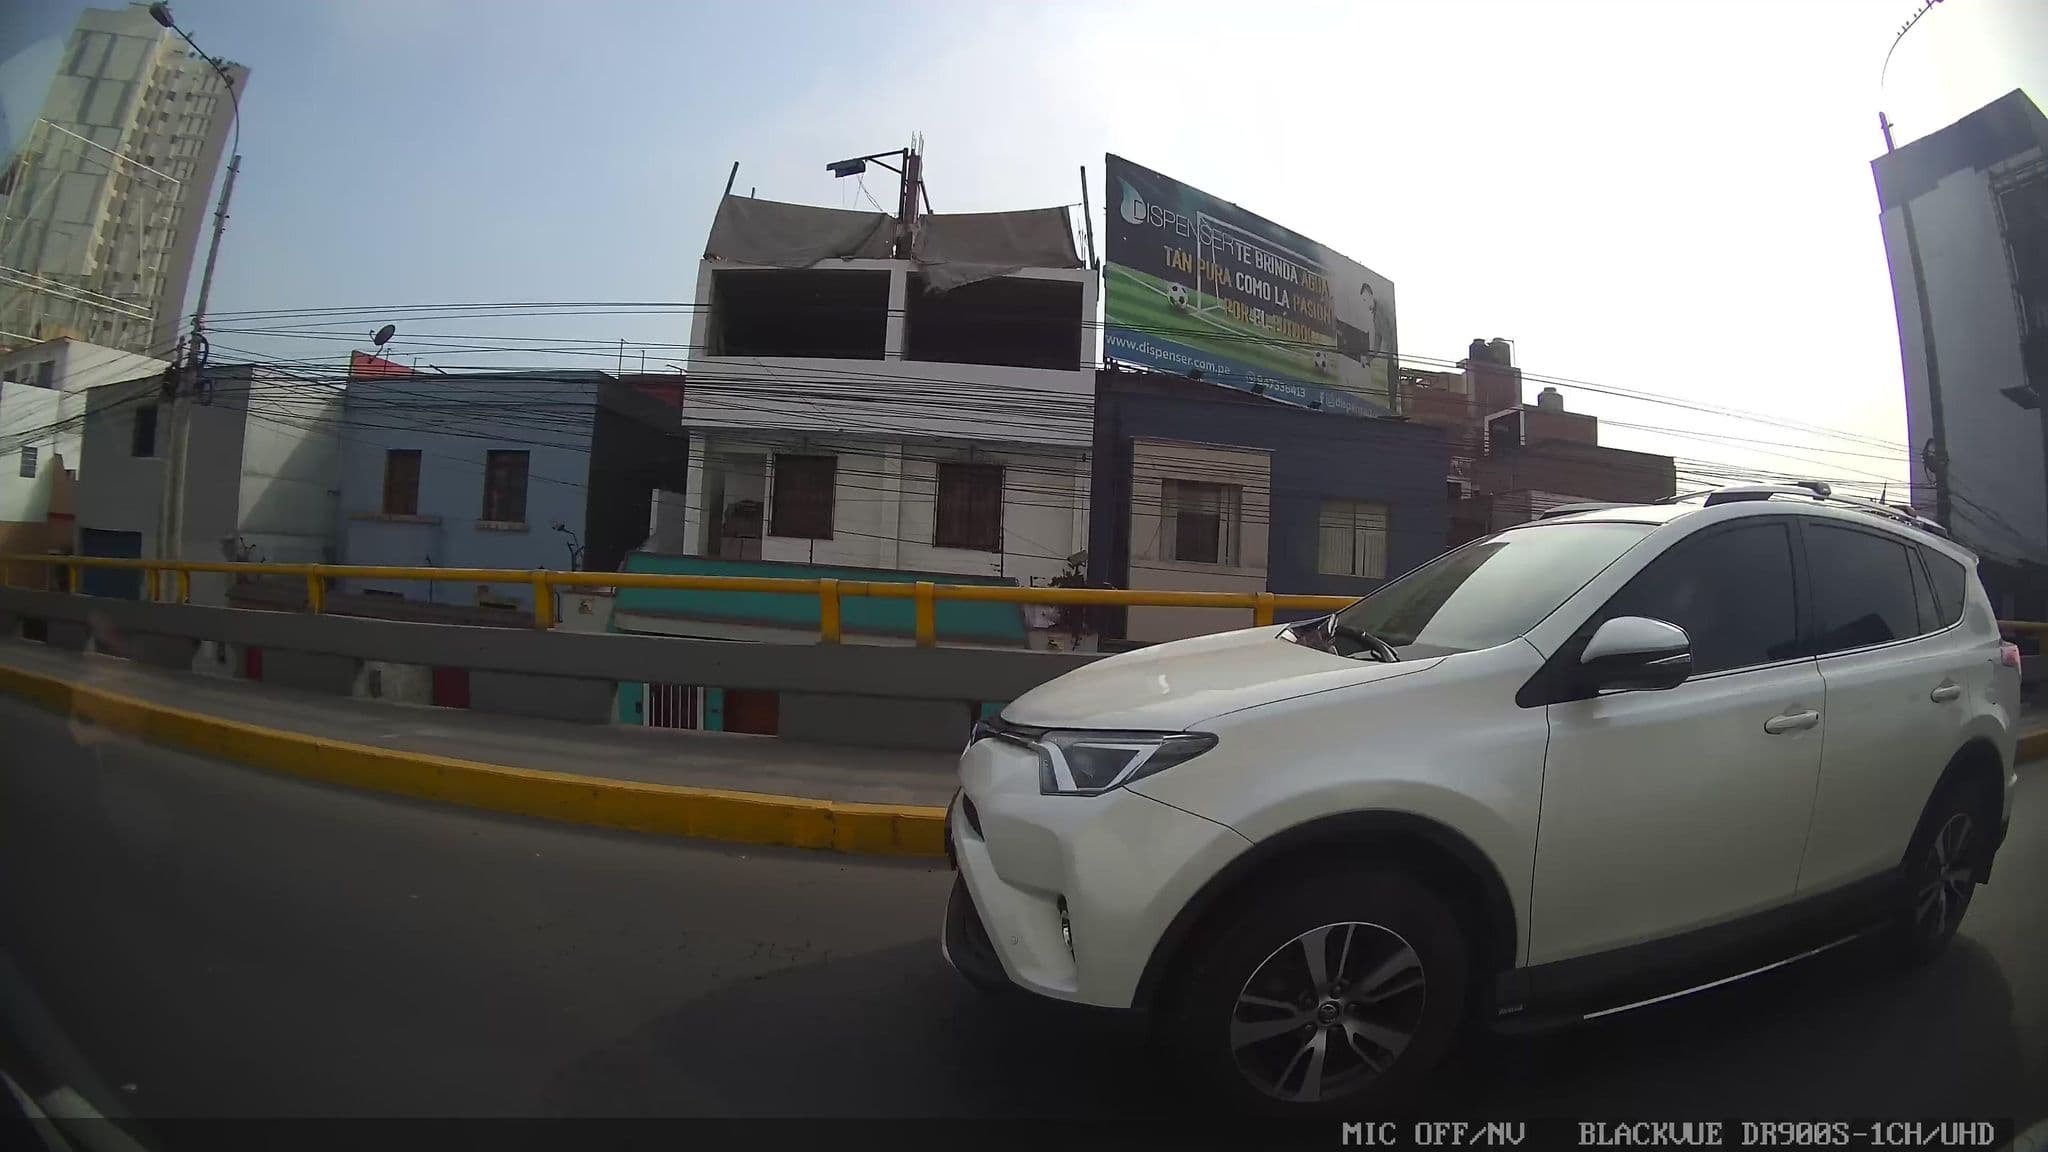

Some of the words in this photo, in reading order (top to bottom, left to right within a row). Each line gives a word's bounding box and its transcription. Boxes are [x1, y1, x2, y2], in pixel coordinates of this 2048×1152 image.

[1132, 199, 1234, 255] DISPENSER
[1236, 242, 1252, 265] TE
[1255, 250, 1299, 285] BRINDA
[1198, 258, 1232, 288] PURA
[1235, 272, 1271, 301] COMO
[1274, 286, 1290, 309] LA
[1106, 334, 1231, 375] www.dispenser.com.pe
